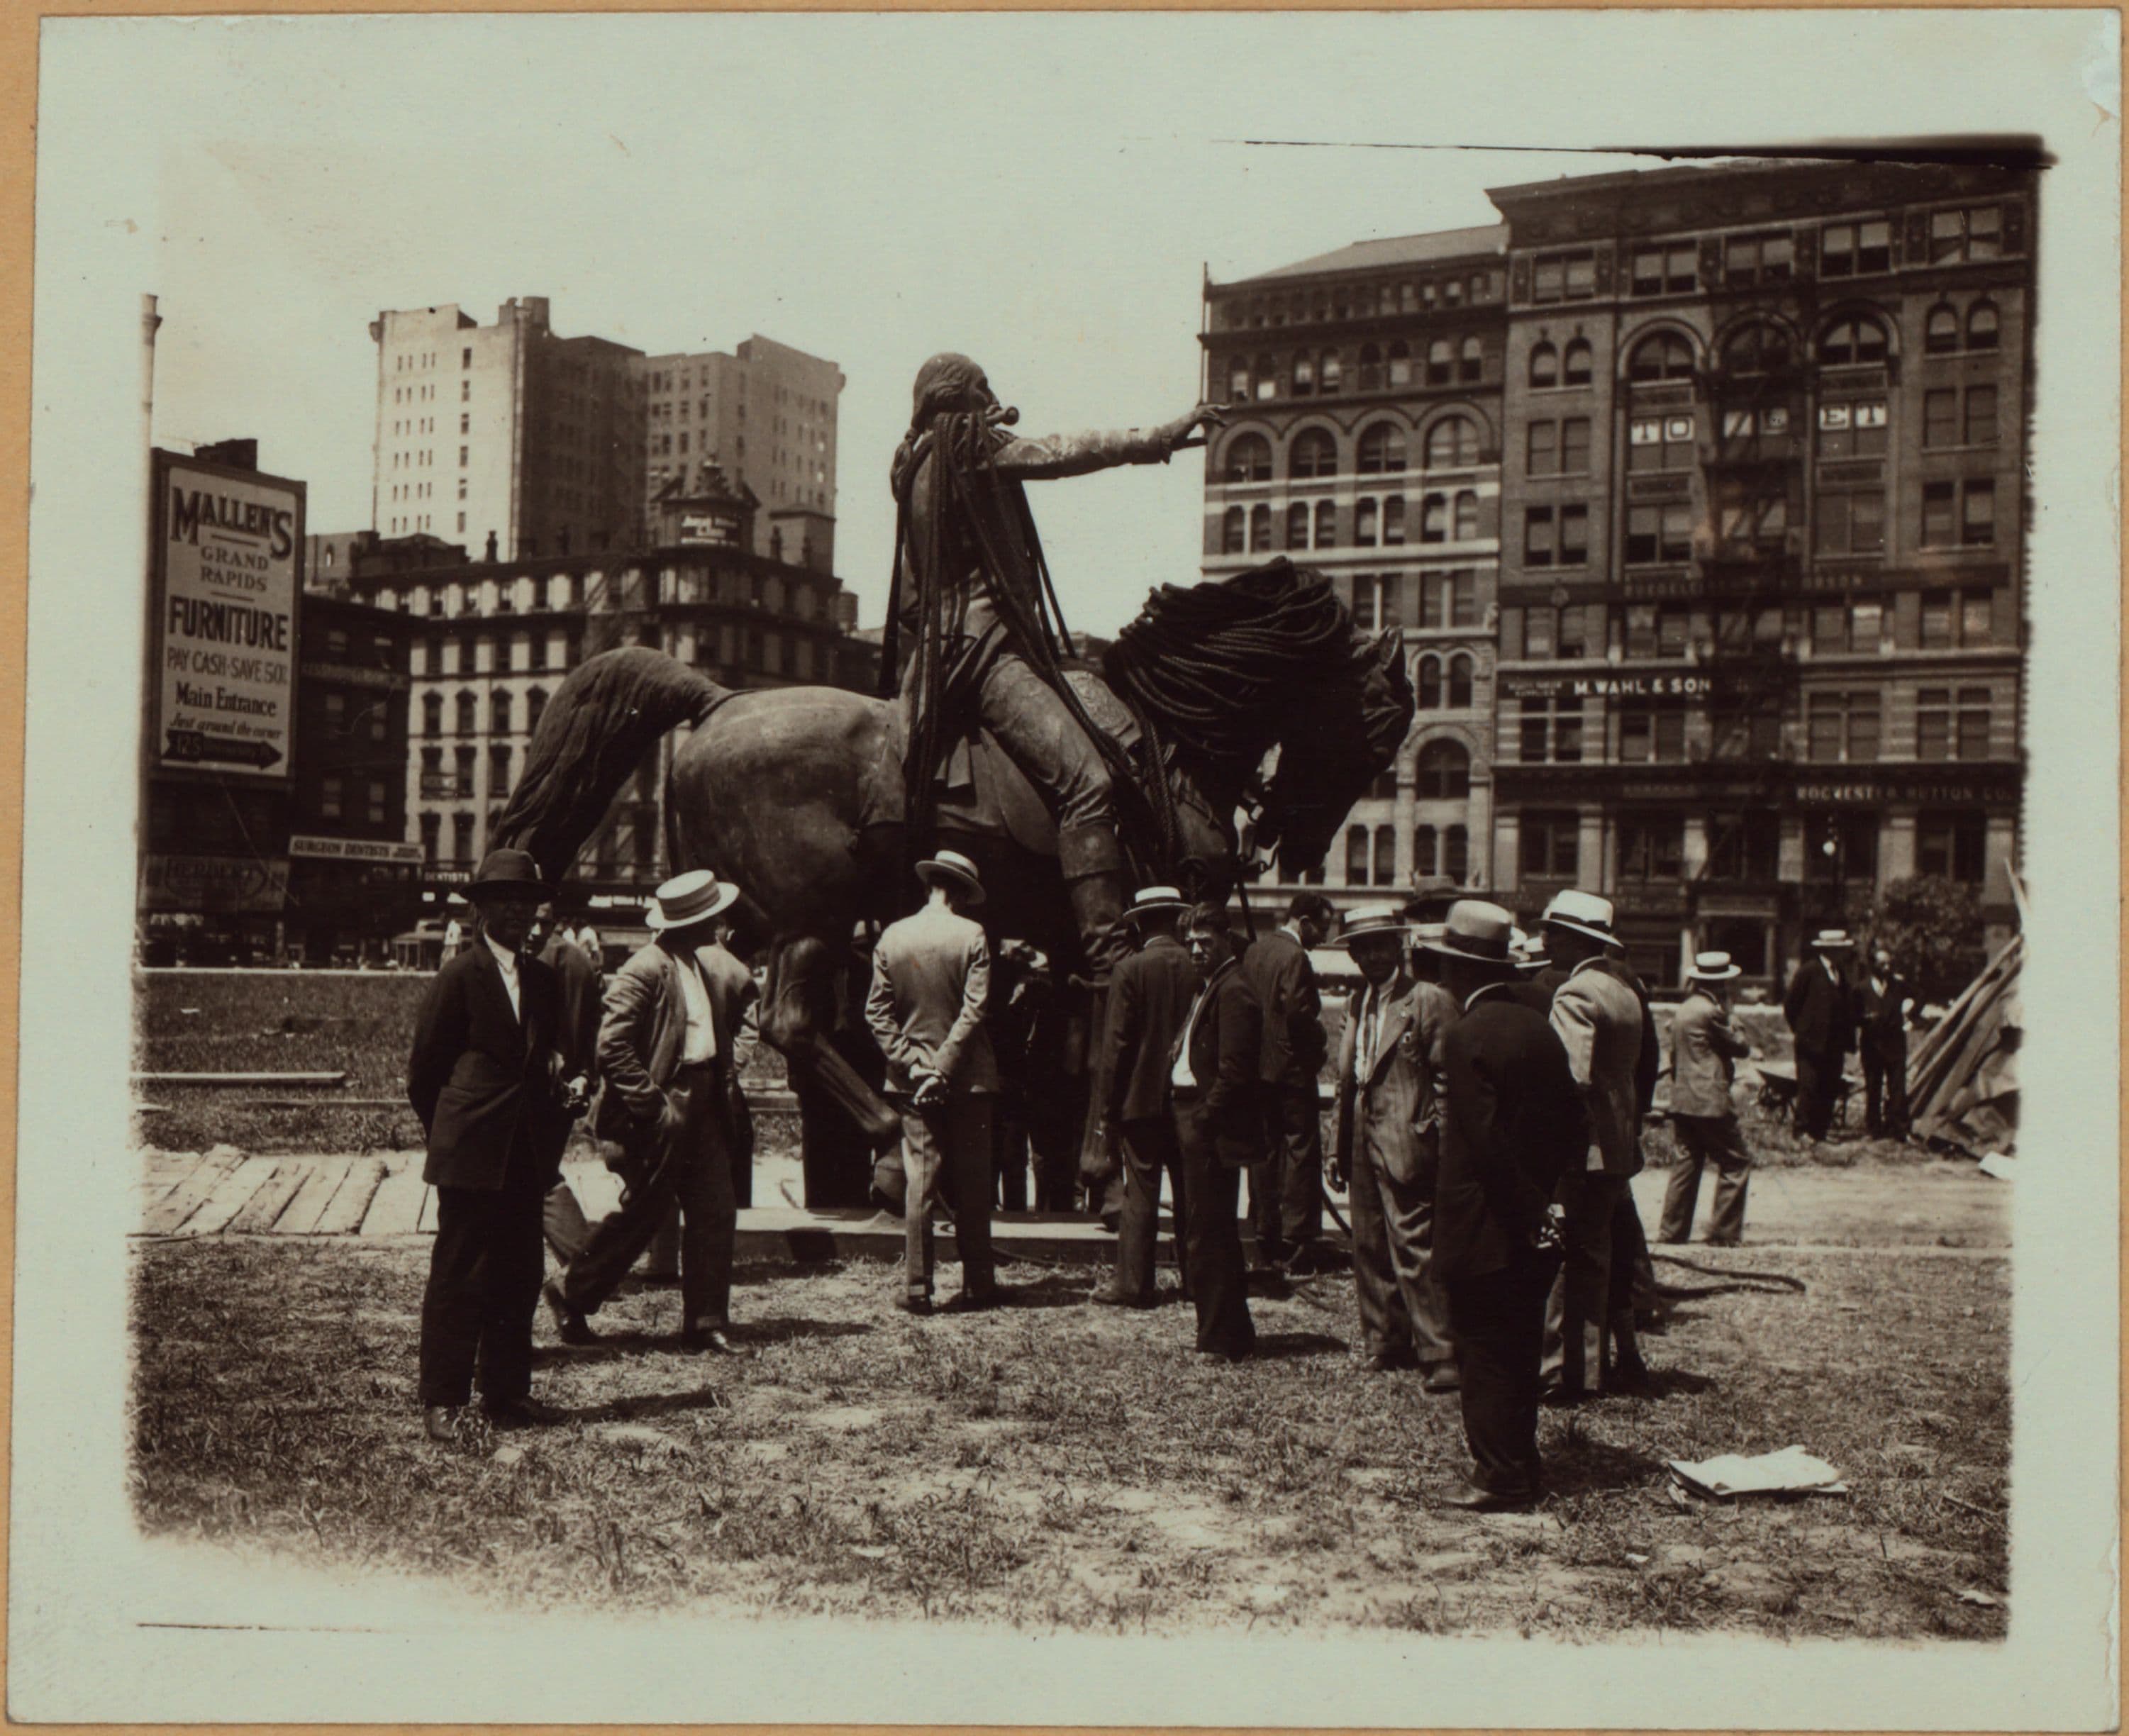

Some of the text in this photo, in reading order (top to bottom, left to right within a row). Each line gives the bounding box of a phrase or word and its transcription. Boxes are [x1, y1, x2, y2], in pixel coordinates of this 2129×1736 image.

[1633, 419, 1690, 441] TO
[200, 545, 268, 571] GRAND
[200, 565, 267, 593] RAPIDS
[169, 595, 289, 652] FURNITURE
[167, 646, 190, 672] PAY
[1595, 679, 1646, 695] WAHL
[1652, 677, 1664, 694] &
[1670, 676, 1712, 694] SON
[175, 680, 277, 718] Main Entrance
[169, 712, 195, 728] Just
[197, 718, 237, 734] around
